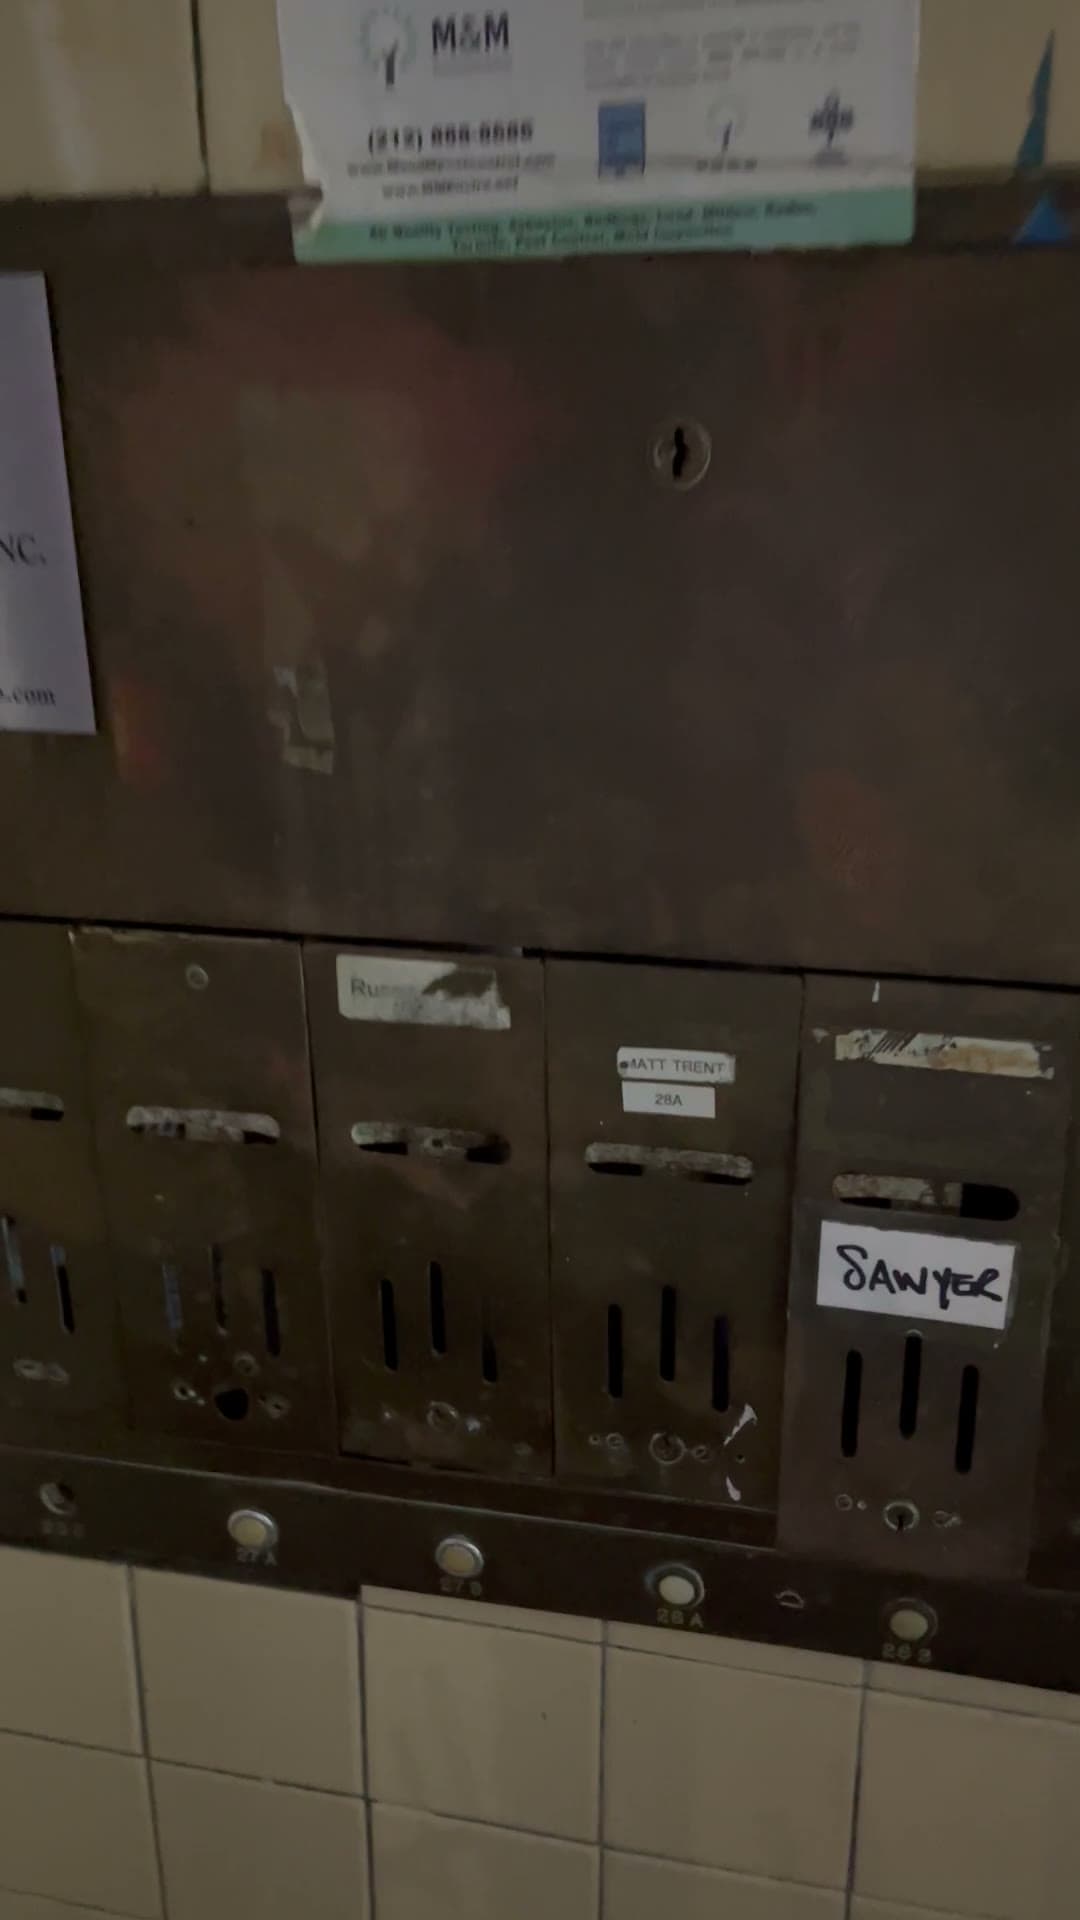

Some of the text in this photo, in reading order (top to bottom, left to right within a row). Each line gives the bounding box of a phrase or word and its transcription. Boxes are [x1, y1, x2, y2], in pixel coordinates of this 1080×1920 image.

[432, 11, 510, 54] M&M
[672, 1059, 726, 1075] TRENT
[654, 1093, 683, 1107] 28A
[836, 1244, 1003, 1311] SAWYER
